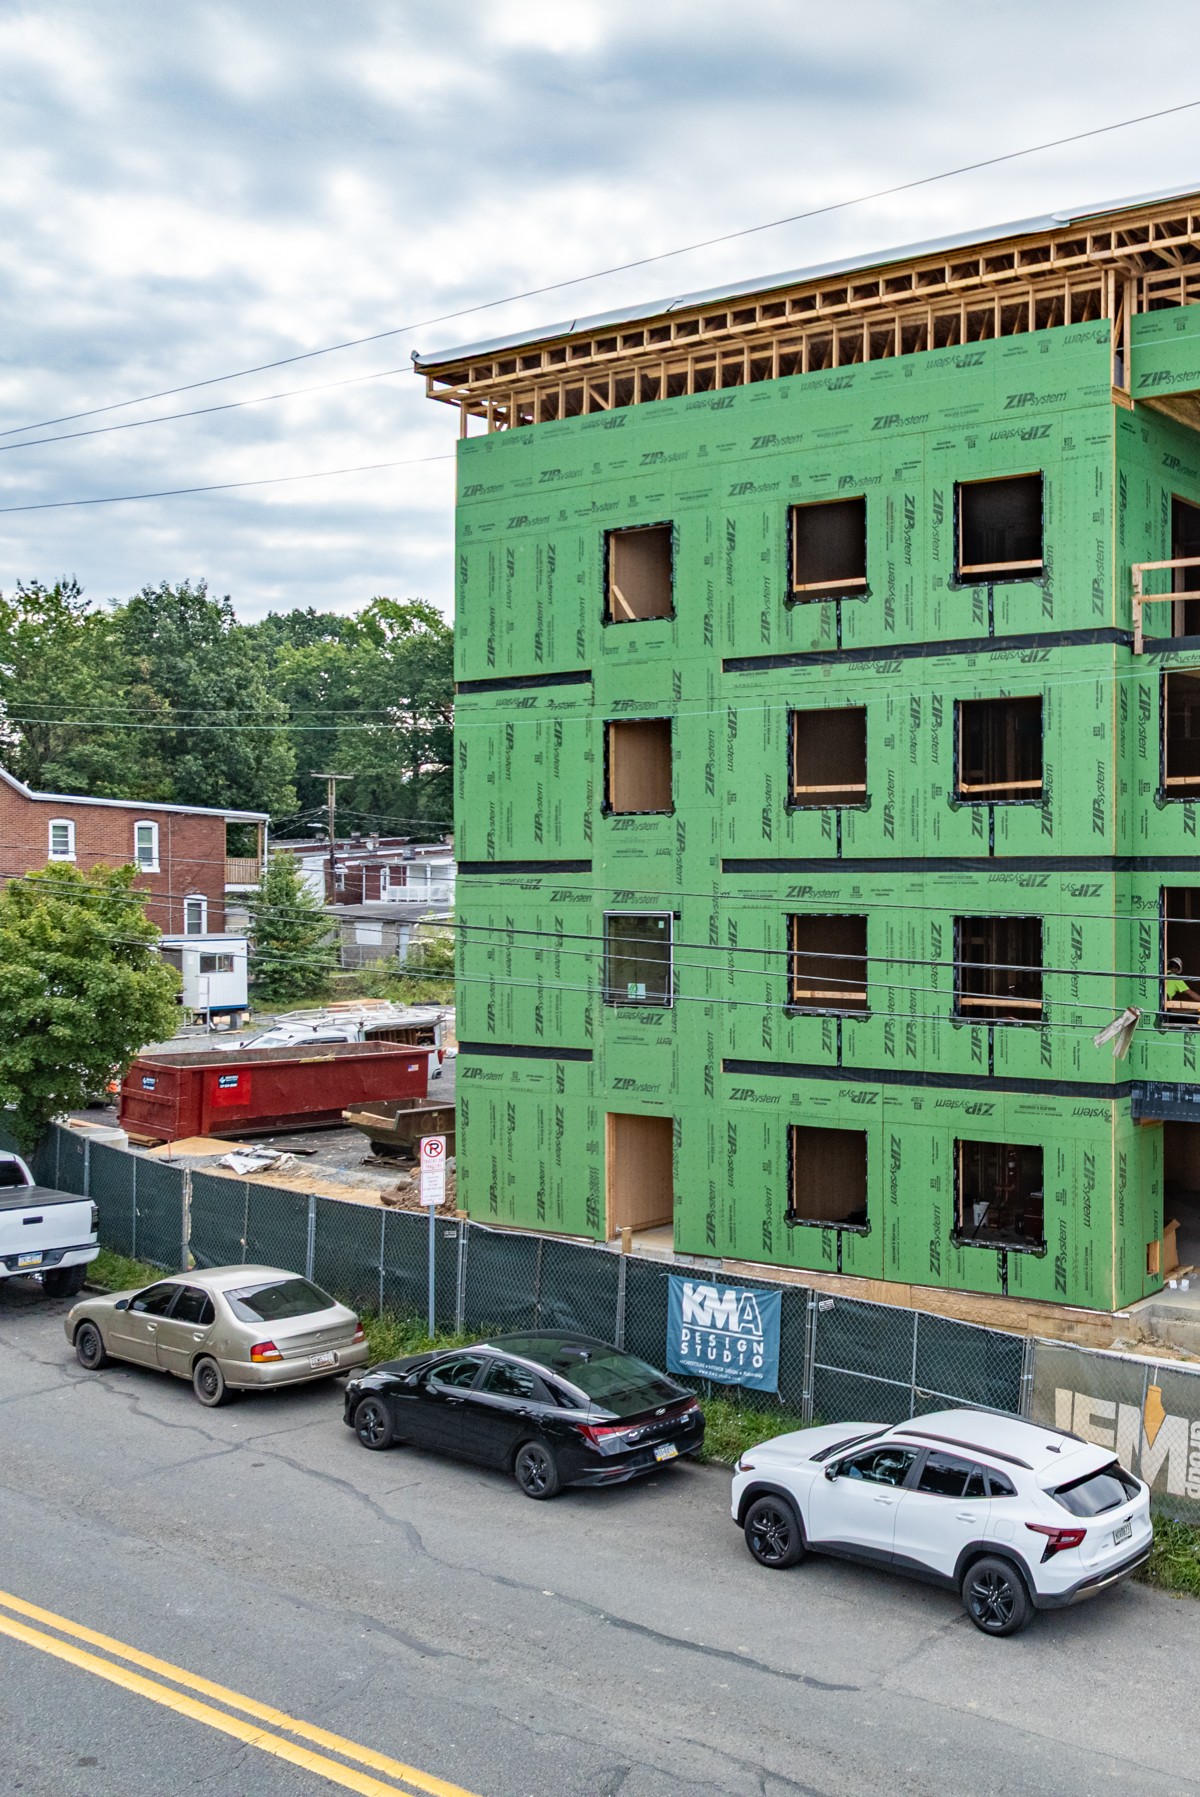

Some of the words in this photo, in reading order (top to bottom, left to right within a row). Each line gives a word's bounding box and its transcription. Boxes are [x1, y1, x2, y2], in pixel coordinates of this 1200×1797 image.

[682, 1283, 763, 1335] KMA
[681, 1329, 764, 1354] DESIGN
[680, 1342, 763, 1368] STUDIO
